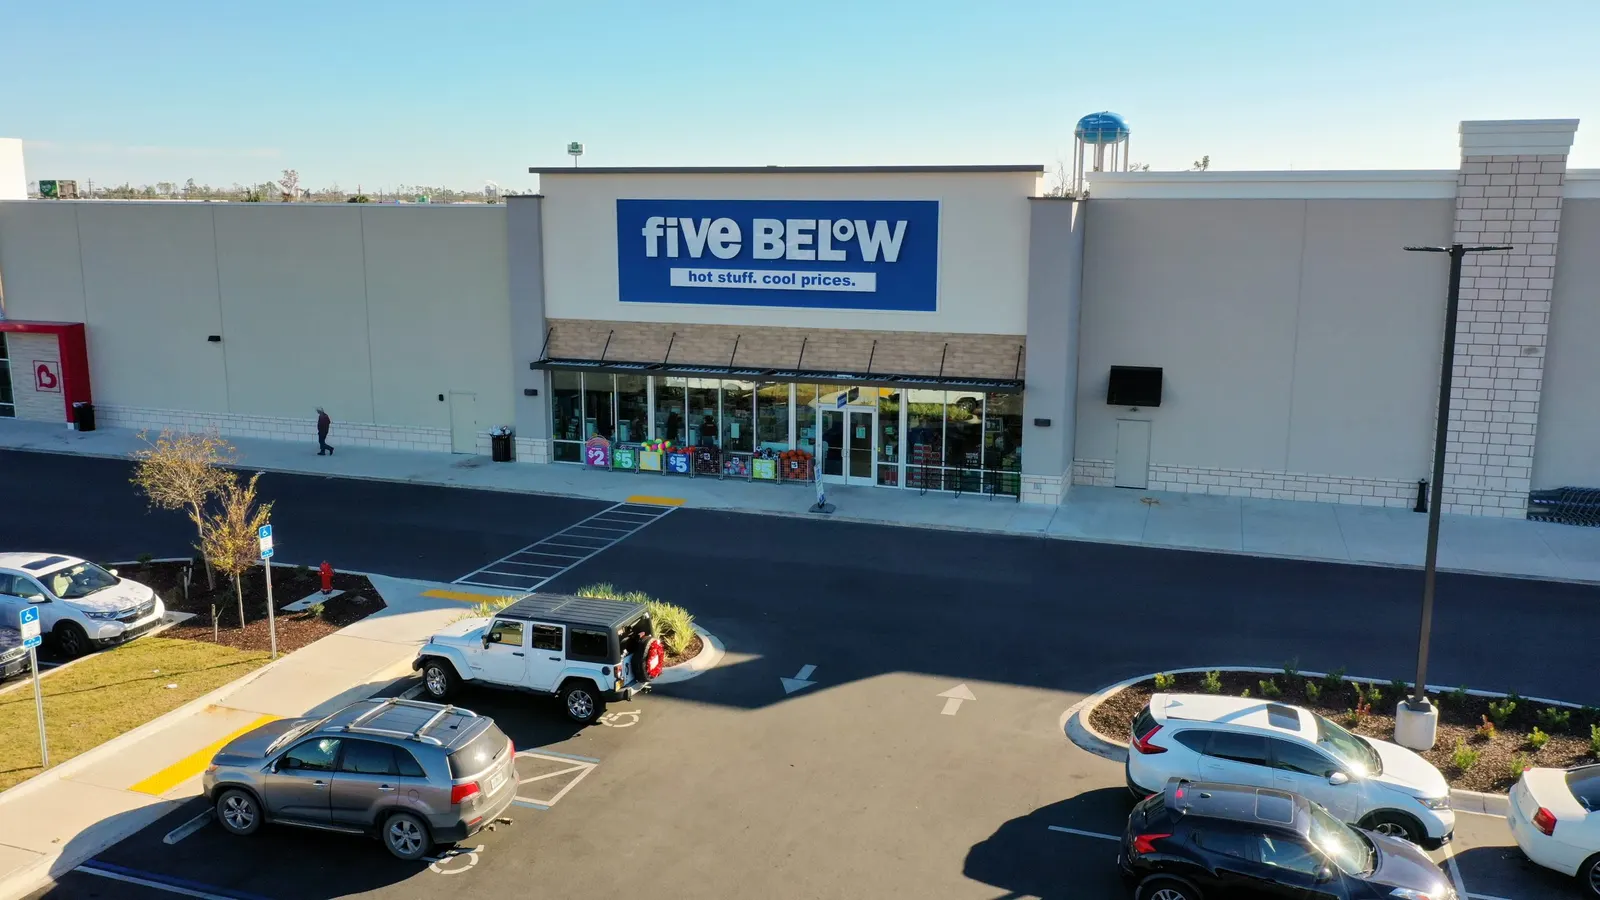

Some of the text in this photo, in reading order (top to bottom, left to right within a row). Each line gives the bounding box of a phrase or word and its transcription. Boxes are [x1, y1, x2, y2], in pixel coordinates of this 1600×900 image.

[642, 216, 742, 260] five
[688, 270, 856, 288] hot stuff. cool prices.
[588, 450, 605, 466] $2
[615, 452, 635, 469] $5
[669, 456, 688, 473] $5
[755, 461, 774, 479] $5
